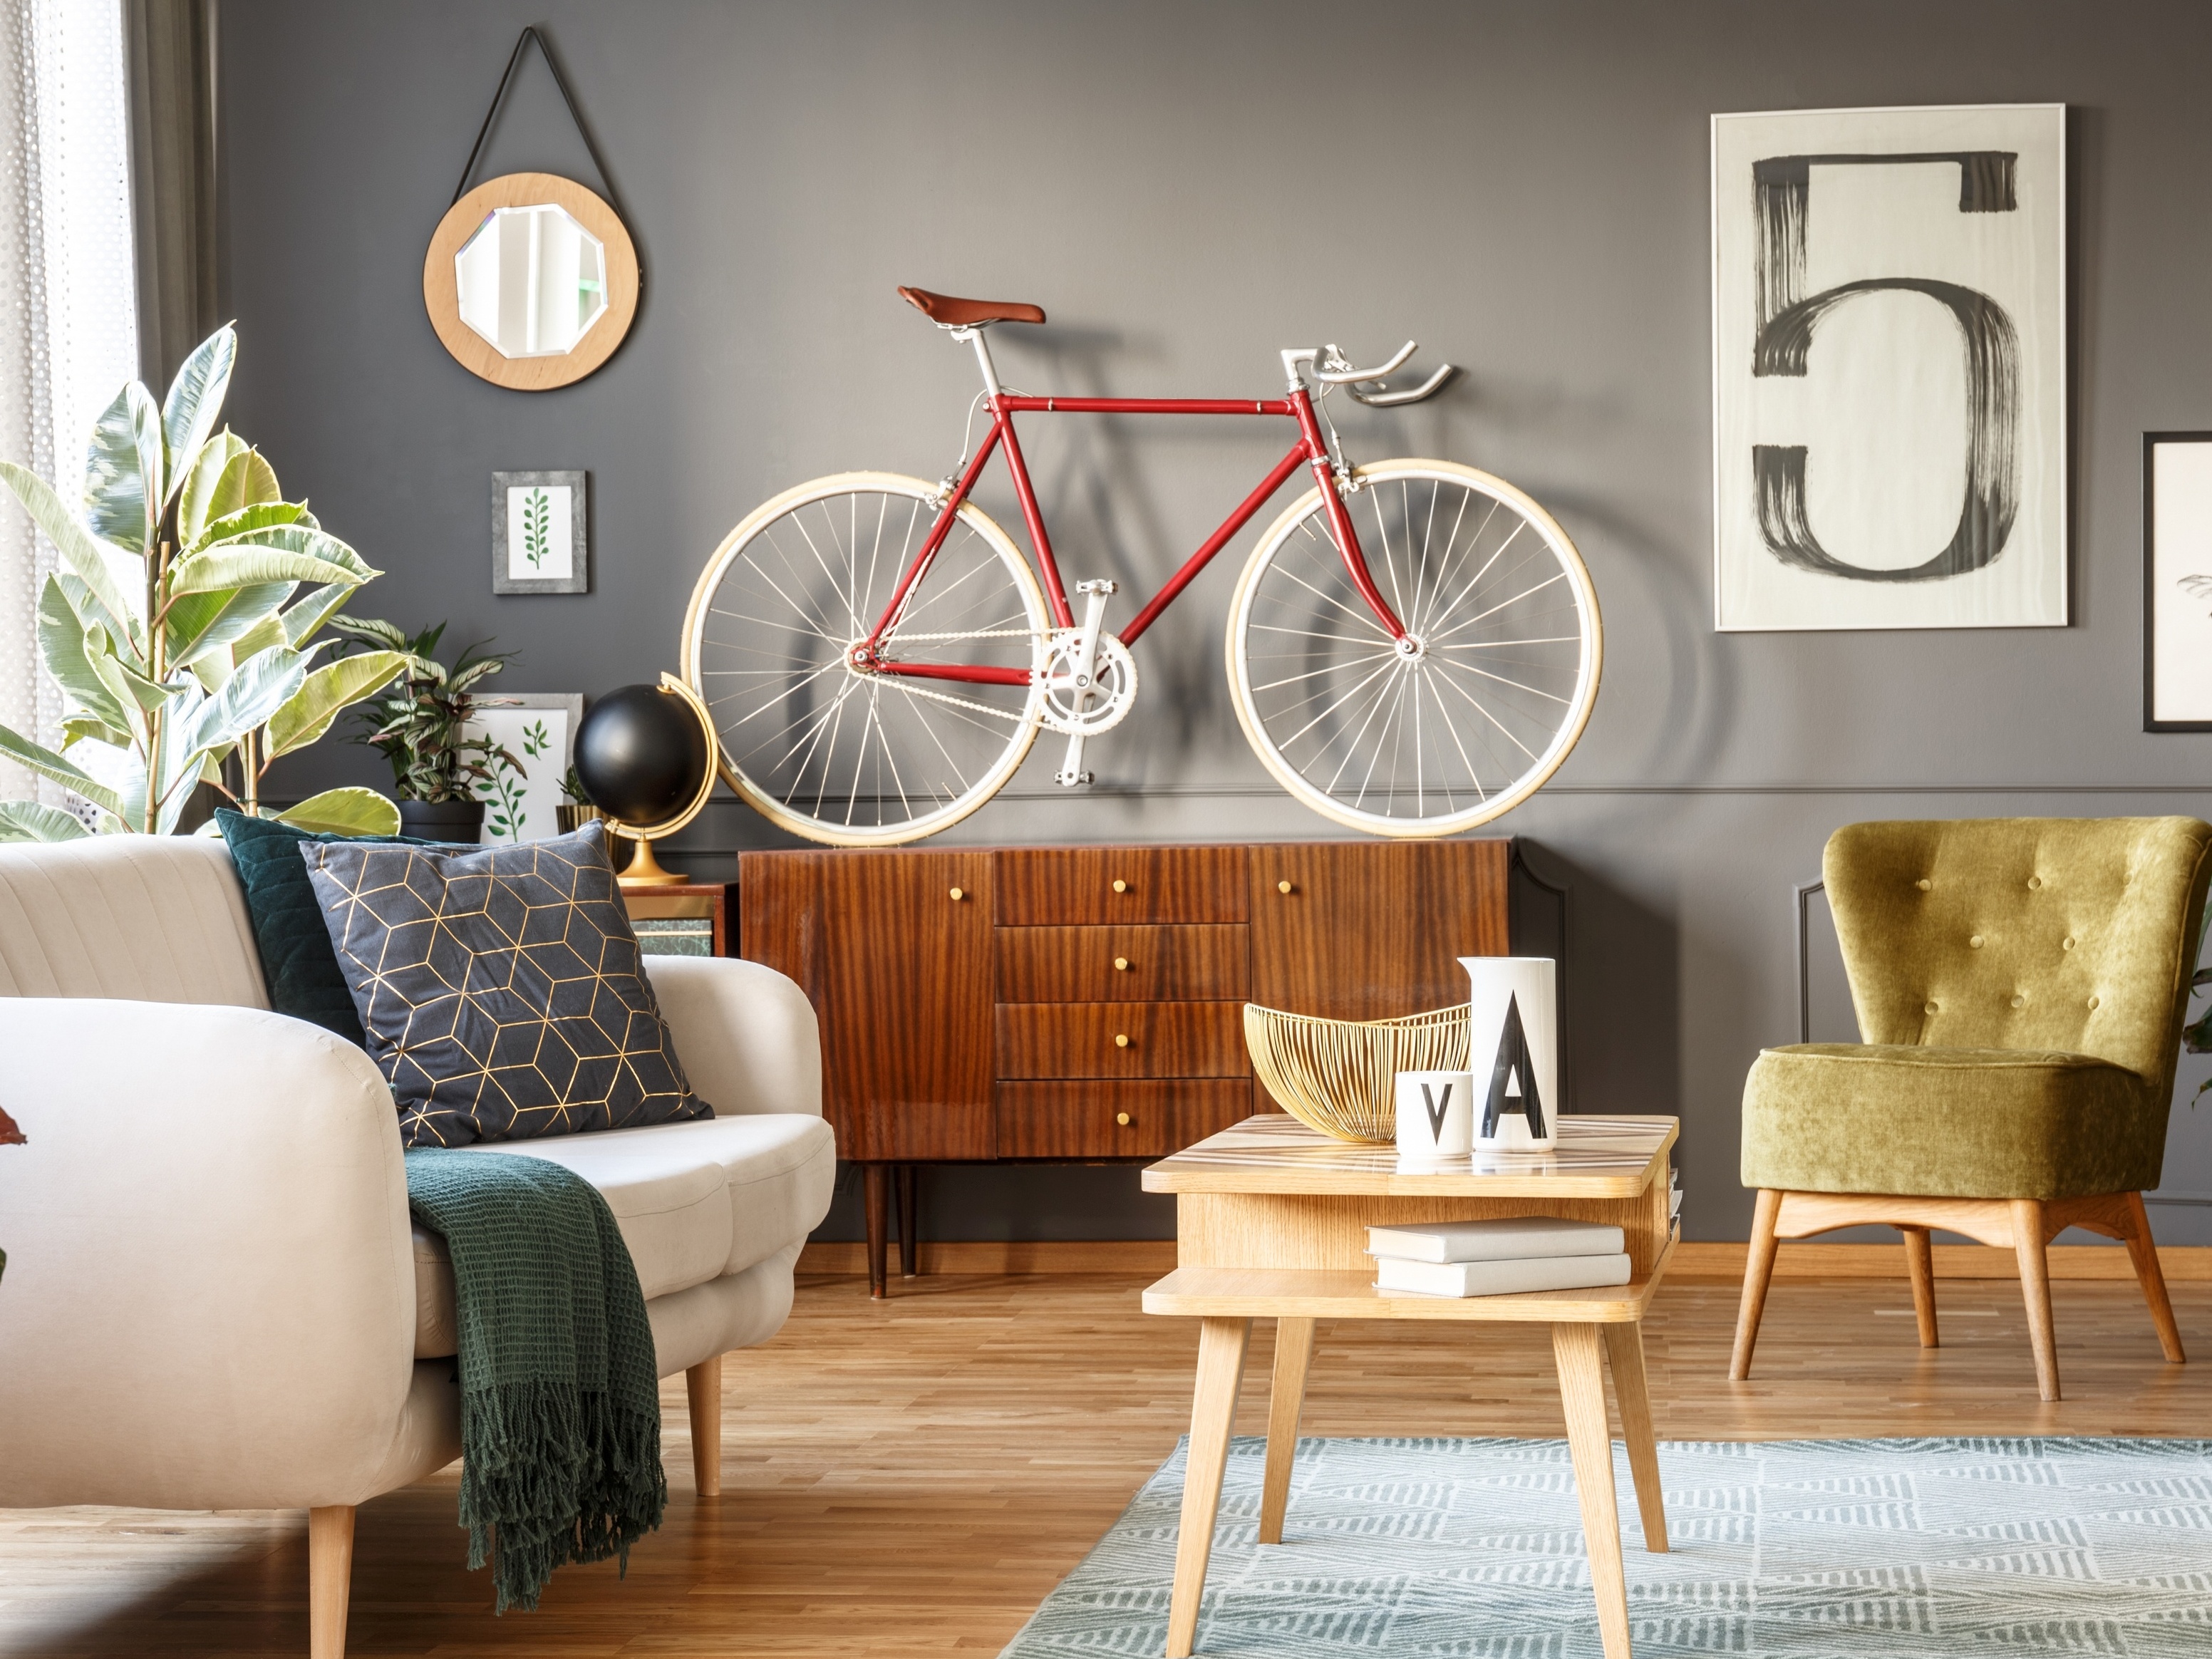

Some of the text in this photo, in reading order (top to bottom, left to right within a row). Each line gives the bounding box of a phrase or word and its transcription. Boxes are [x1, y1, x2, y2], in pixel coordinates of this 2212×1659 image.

[1751, 151, 2022, 583] 5
[1421, 1083, 1453, 1146] V
[1480, 989, 1548, 1139] A
